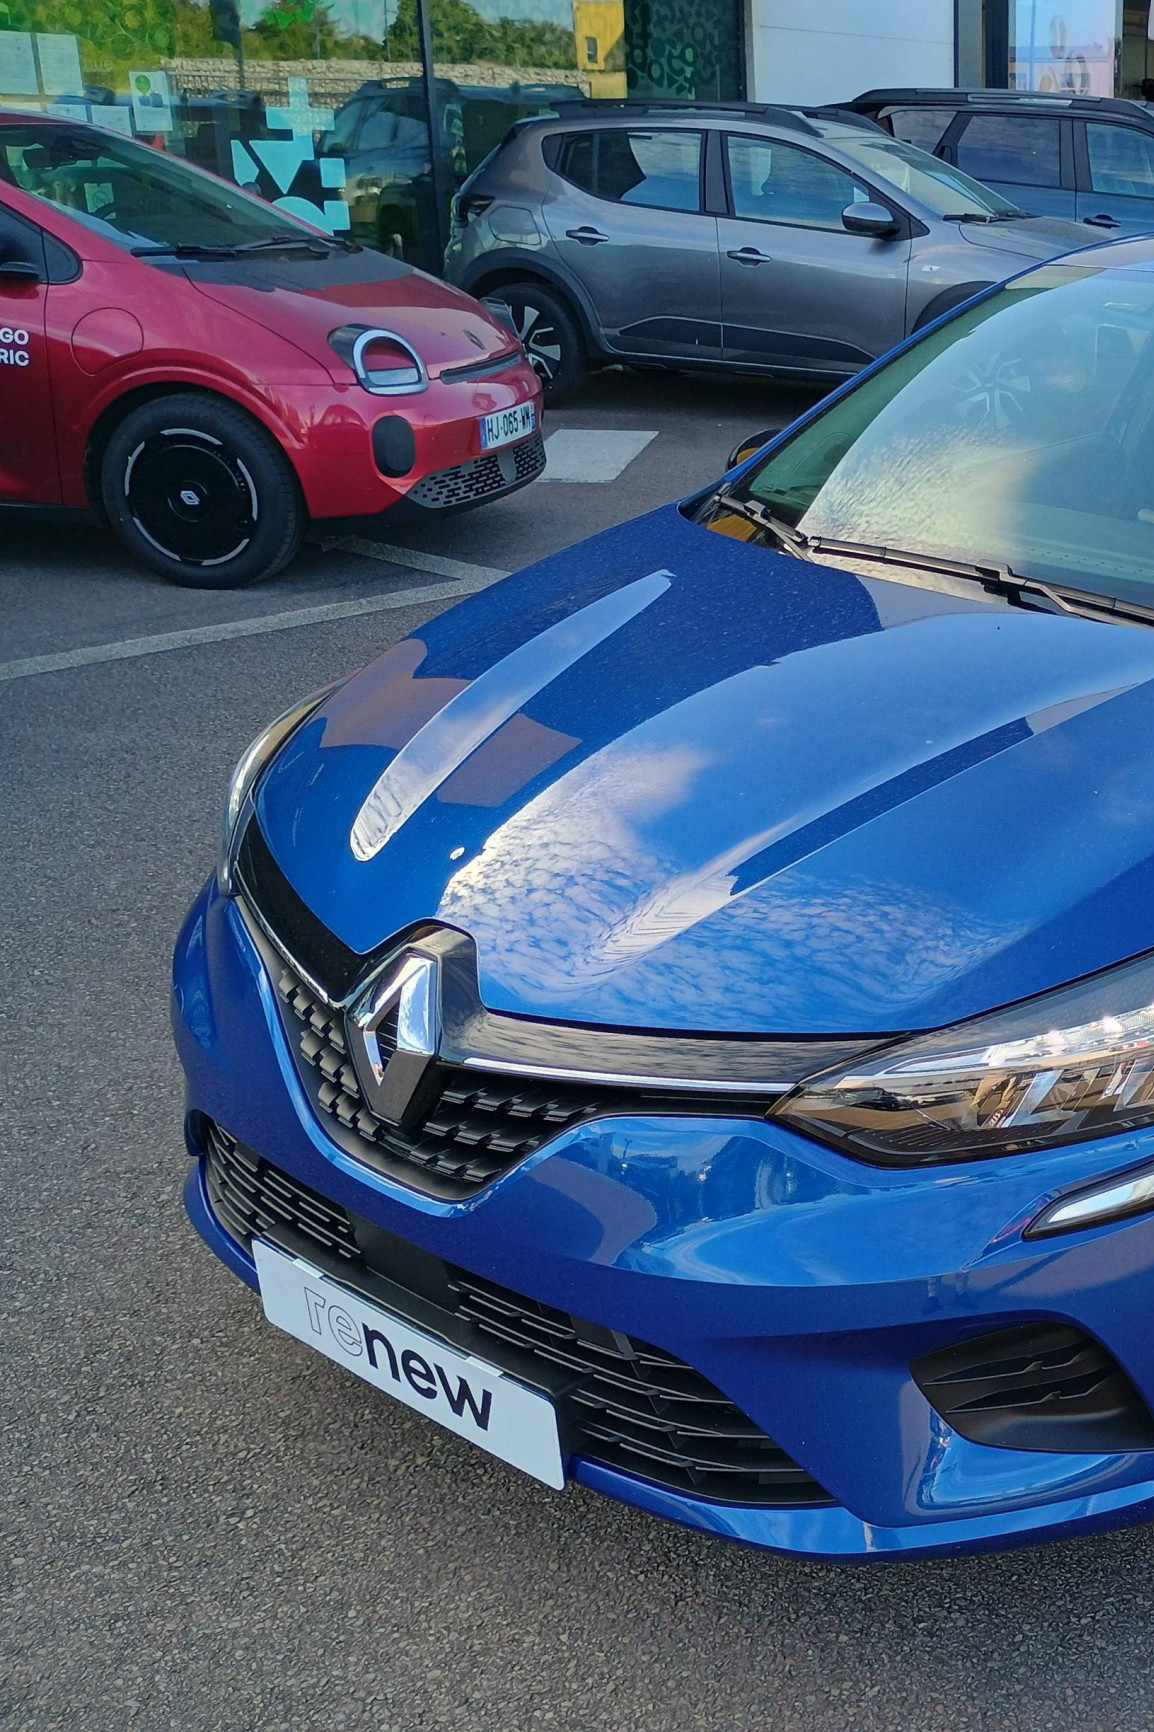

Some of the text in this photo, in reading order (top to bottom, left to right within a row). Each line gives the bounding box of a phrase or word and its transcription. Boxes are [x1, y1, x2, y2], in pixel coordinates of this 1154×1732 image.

[0, 327, 29, 346] GO
[0, 348, 30, 367] RIC
[304, 1286, 493, 1431] renew
